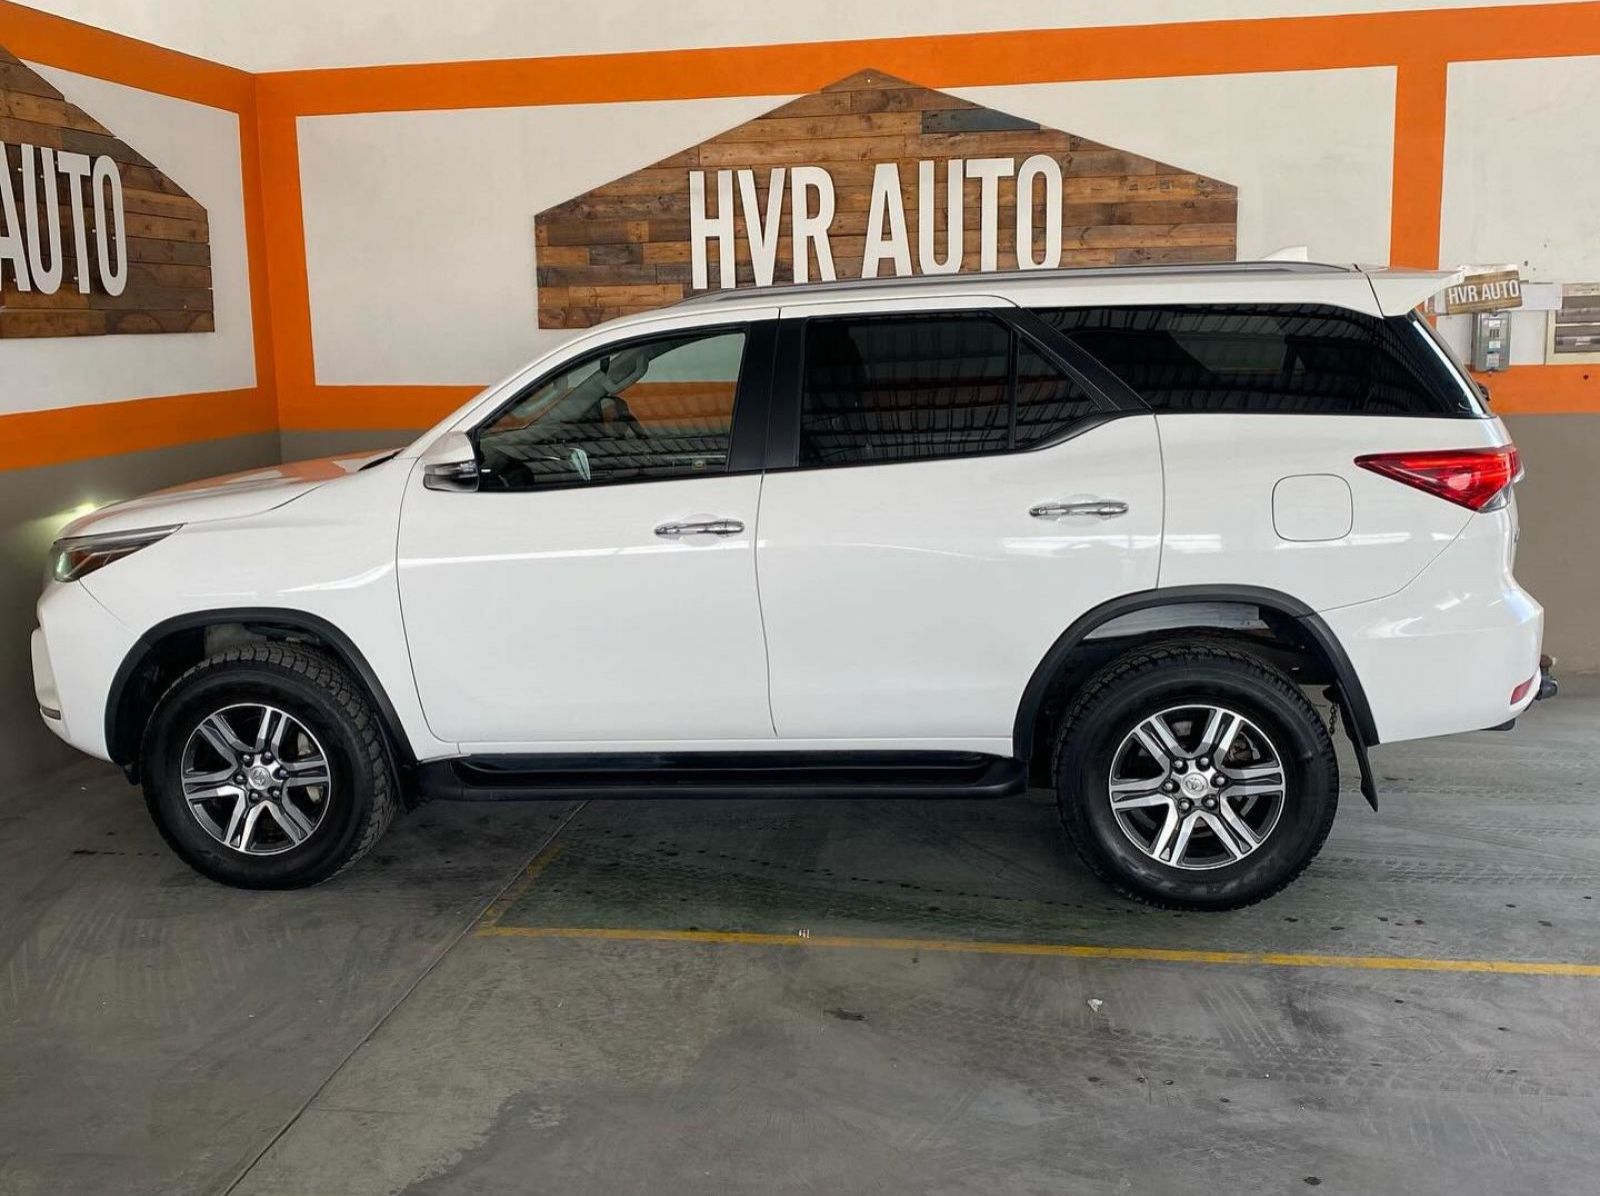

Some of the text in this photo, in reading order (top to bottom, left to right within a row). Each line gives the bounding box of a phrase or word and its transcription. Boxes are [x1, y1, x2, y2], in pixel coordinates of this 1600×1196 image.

[689, 154, 1063, 289] HVR AUTO
[1449, 279, 1519, 305] HVR AUTO
